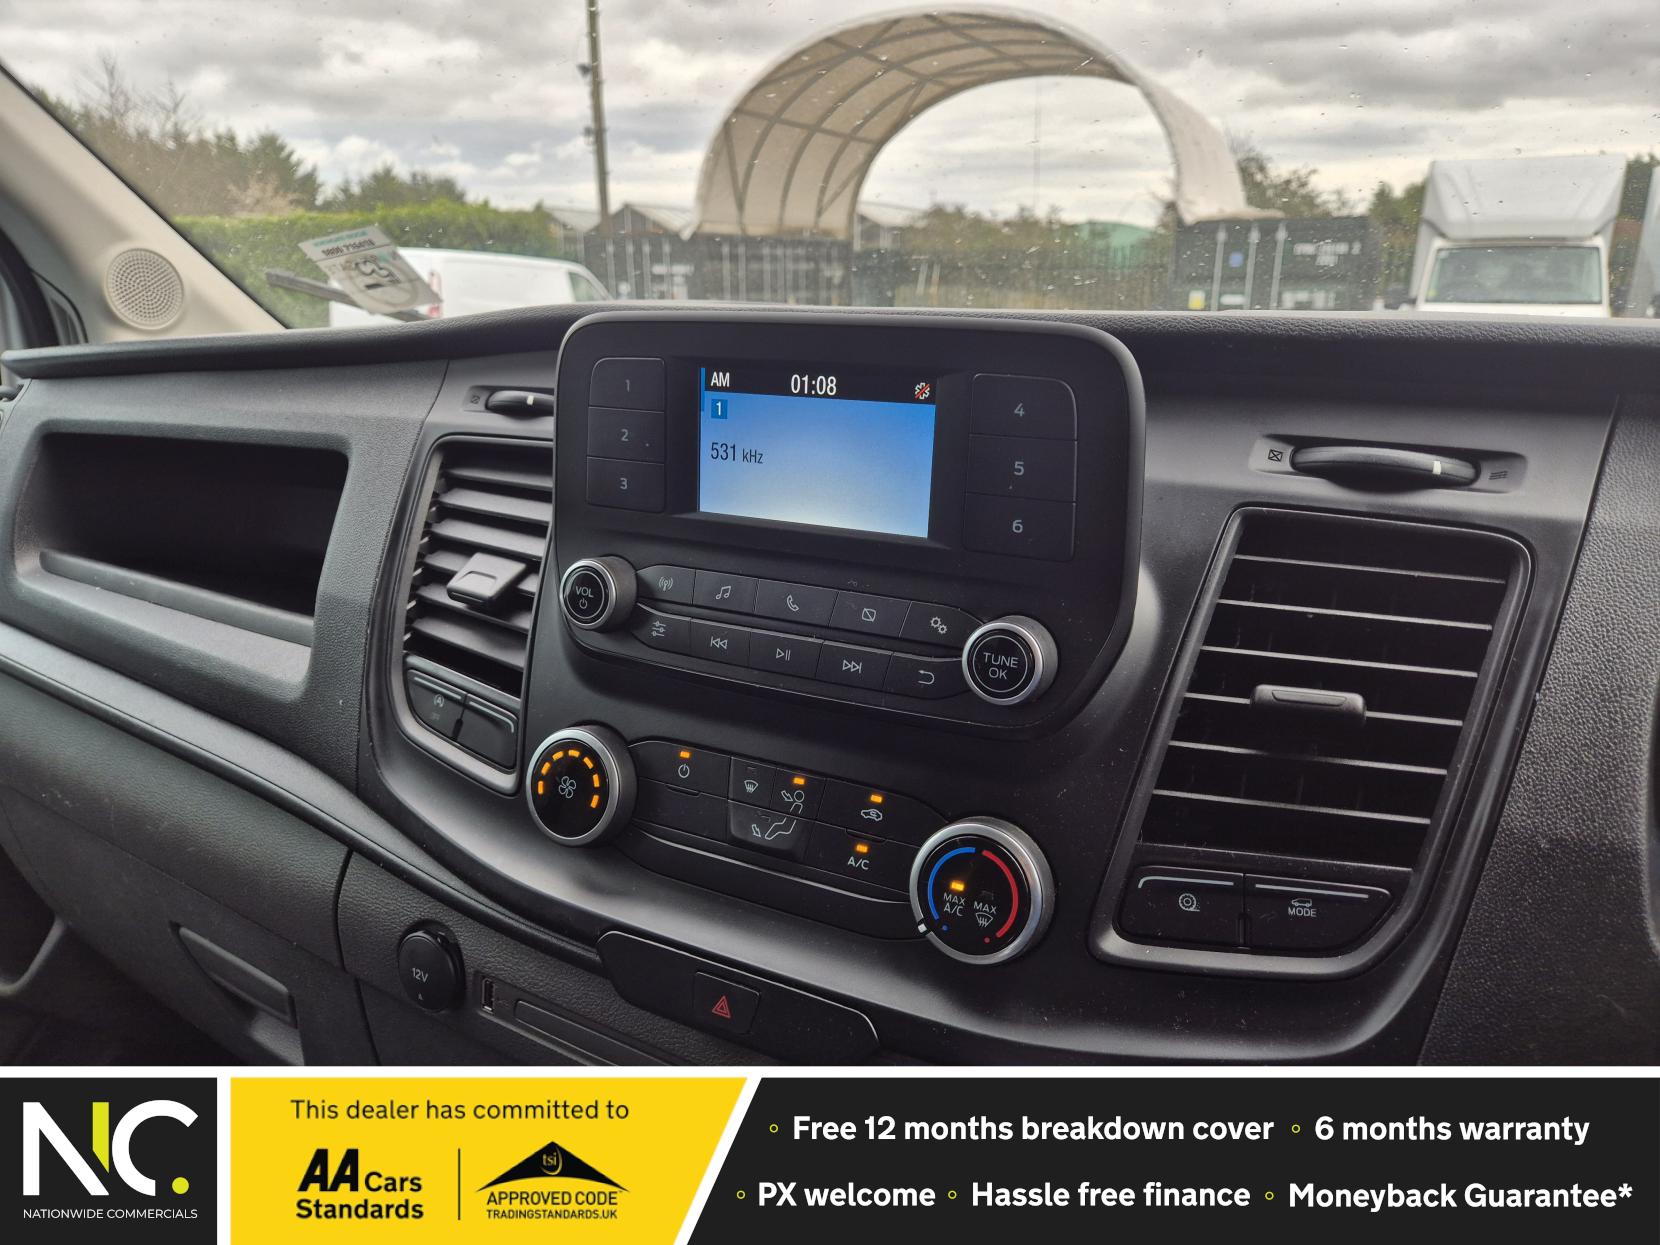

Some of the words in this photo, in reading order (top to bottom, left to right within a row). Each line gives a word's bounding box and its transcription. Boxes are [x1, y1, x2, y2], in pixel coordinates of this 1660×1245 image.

[625, 379, 631, 393] 1
[711, 372, 729, 387] AM
[790, 374, 837, 397] 01:08
[716, 401, 722, 416] 1
[1013, 402, 1025, 417] 4
[621, 428, 629, 442] 2
[711, 442, 735, 461] 531
[743, 448, 763, 463] kHz
[1013, 460, 1025, 476] 5
[619, 477, 628, 490] 3
[1012, 519, 1024, 534] 6
[575, 586, 595, 599] VOL
[983, 651, 1019, 669] TUNE
[988, 665, 1008, 681] OK
[848, 856, 870, 871] A/C
[943, 892, 966, 905] MAX
[943, 903, 965, 917] A/C
[973, 901, 997, 914] MAX
[1287, 907, 1317, 918] MODE
[411, 967, 429, 982] 12V
